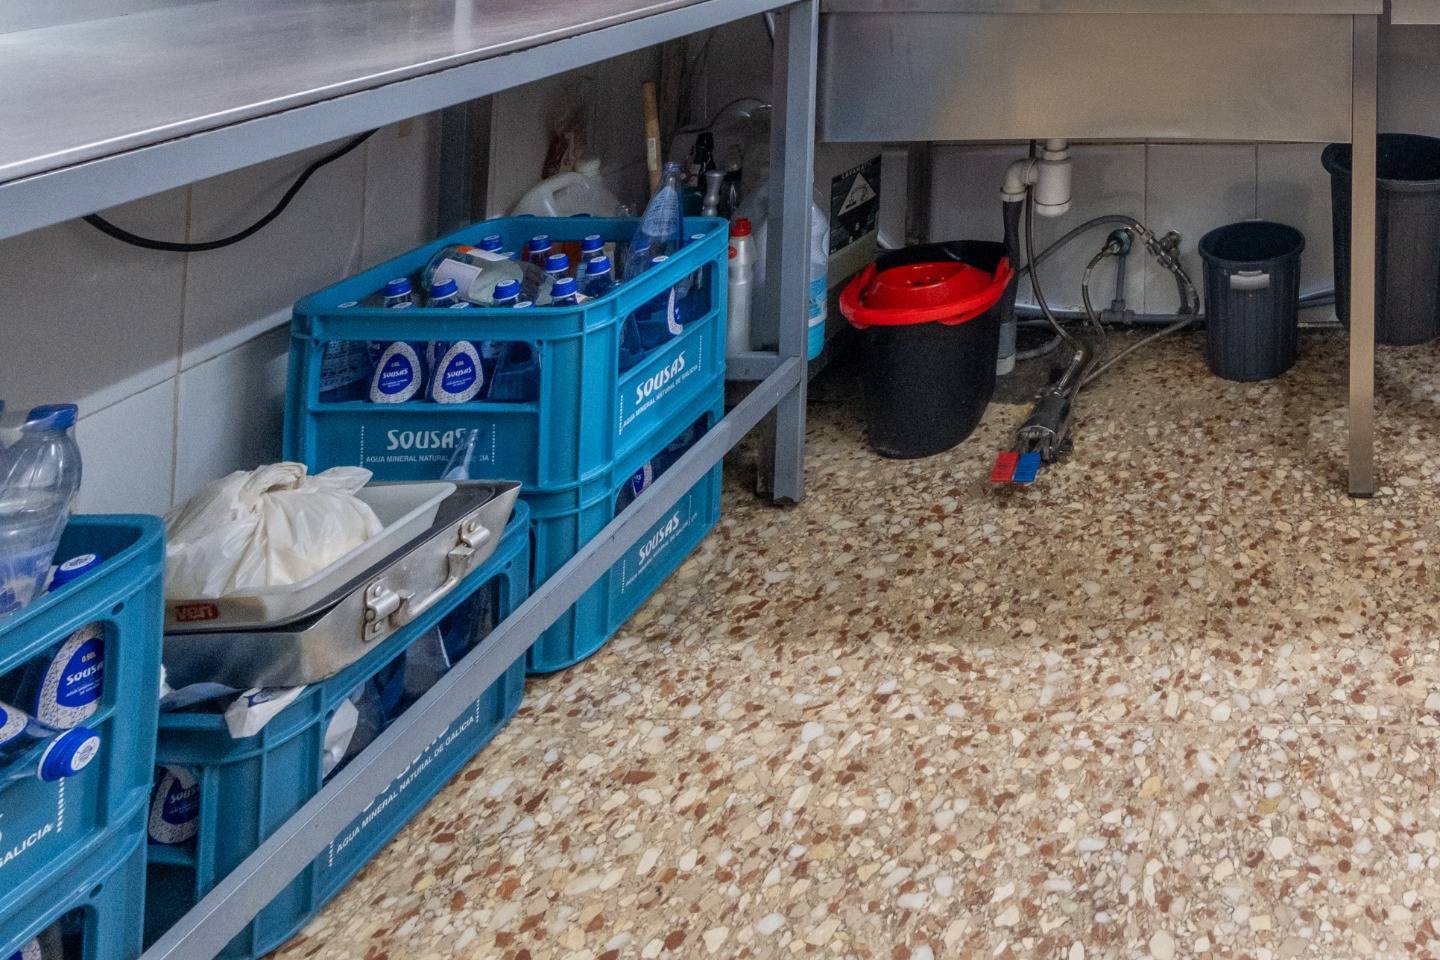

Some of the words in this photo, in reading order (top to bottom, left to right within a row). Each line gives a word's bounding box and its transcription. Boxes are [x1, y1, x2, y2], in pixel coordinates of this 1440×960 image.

[636, 350, 686, 406] SOUSAS
[638, 510, 680, 566] SOUSAS
[336, 827, 361, 854] AGUA
[361, 792, 399, 831] MINERAL
[399, 757, 434, 792] NATURAL
[433, 743, 445, 758] DE
[445, 715, 476, 745] GALICIA
